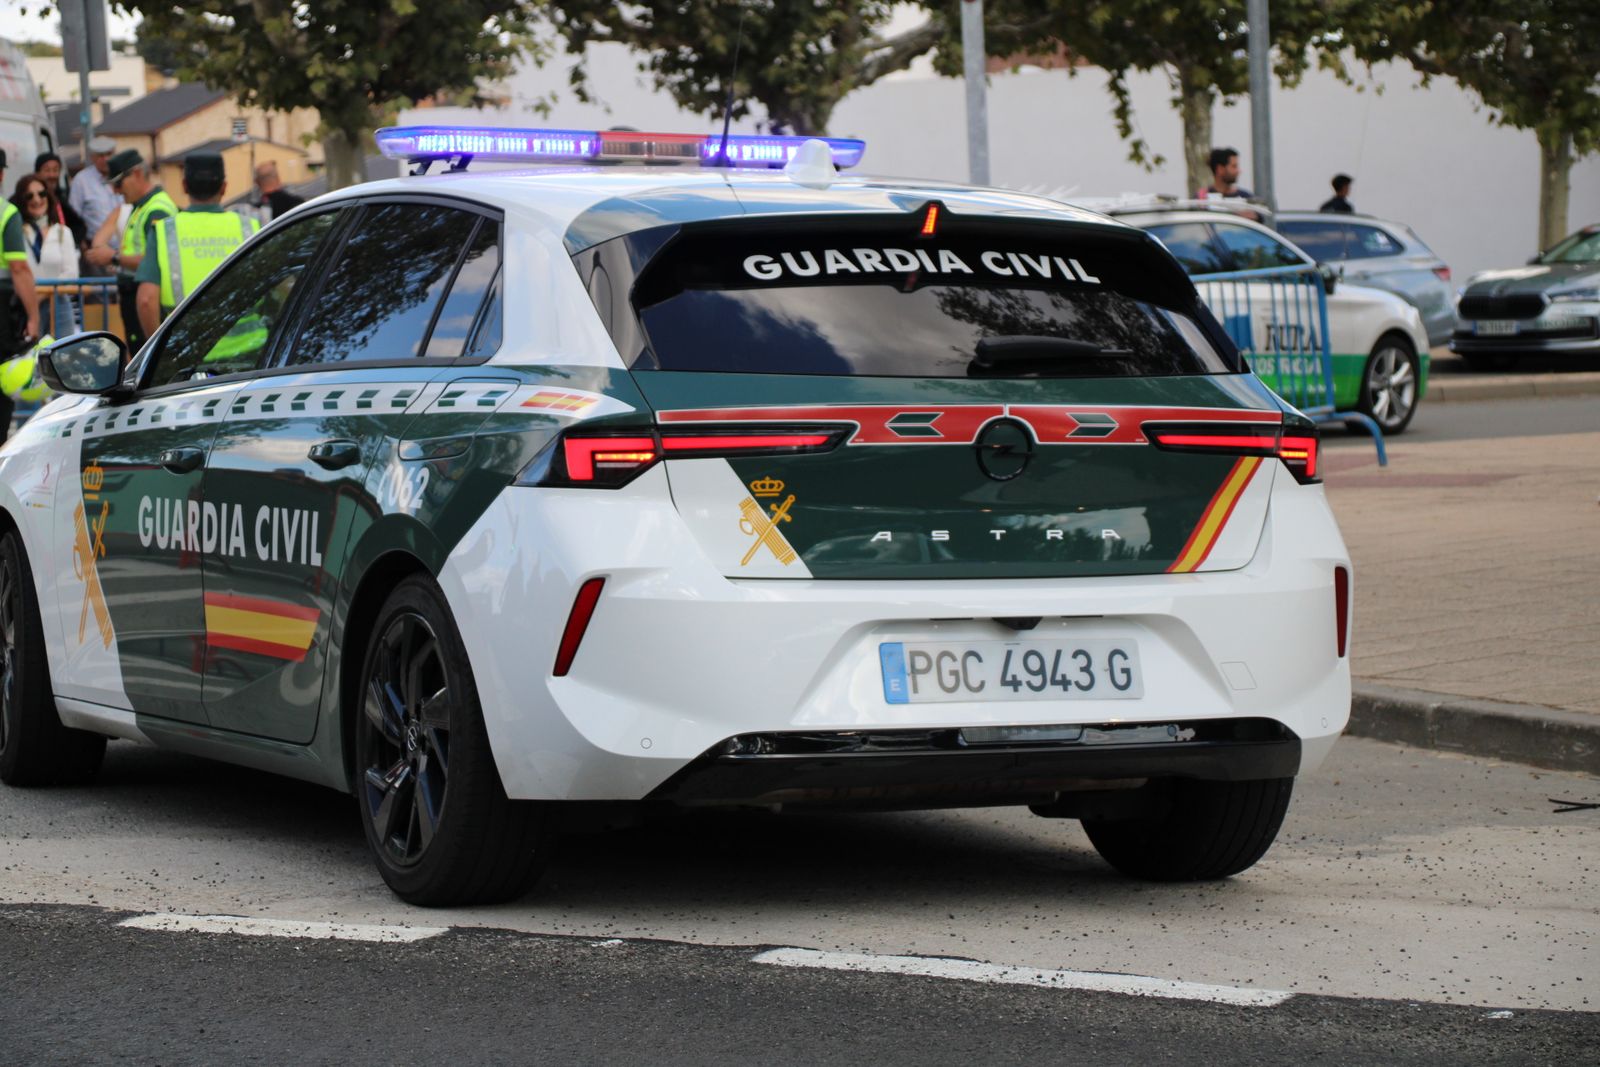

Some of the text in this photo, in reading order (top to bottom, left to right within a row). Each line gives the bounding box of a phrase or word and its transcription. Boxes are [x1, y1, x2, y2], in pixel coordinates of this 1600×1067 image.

[181, 236, 239, 247] GUARDIA
[743, 248, 1101, 284] GUARDIA CIVIL
[388, 464, 430, 509] 062
[138, 495, 322, 567] GUARDIA CIVIL
[870, 529, 1121, 542] ASTRA
[908, 648, 1132, 694] PGC 4943 G
